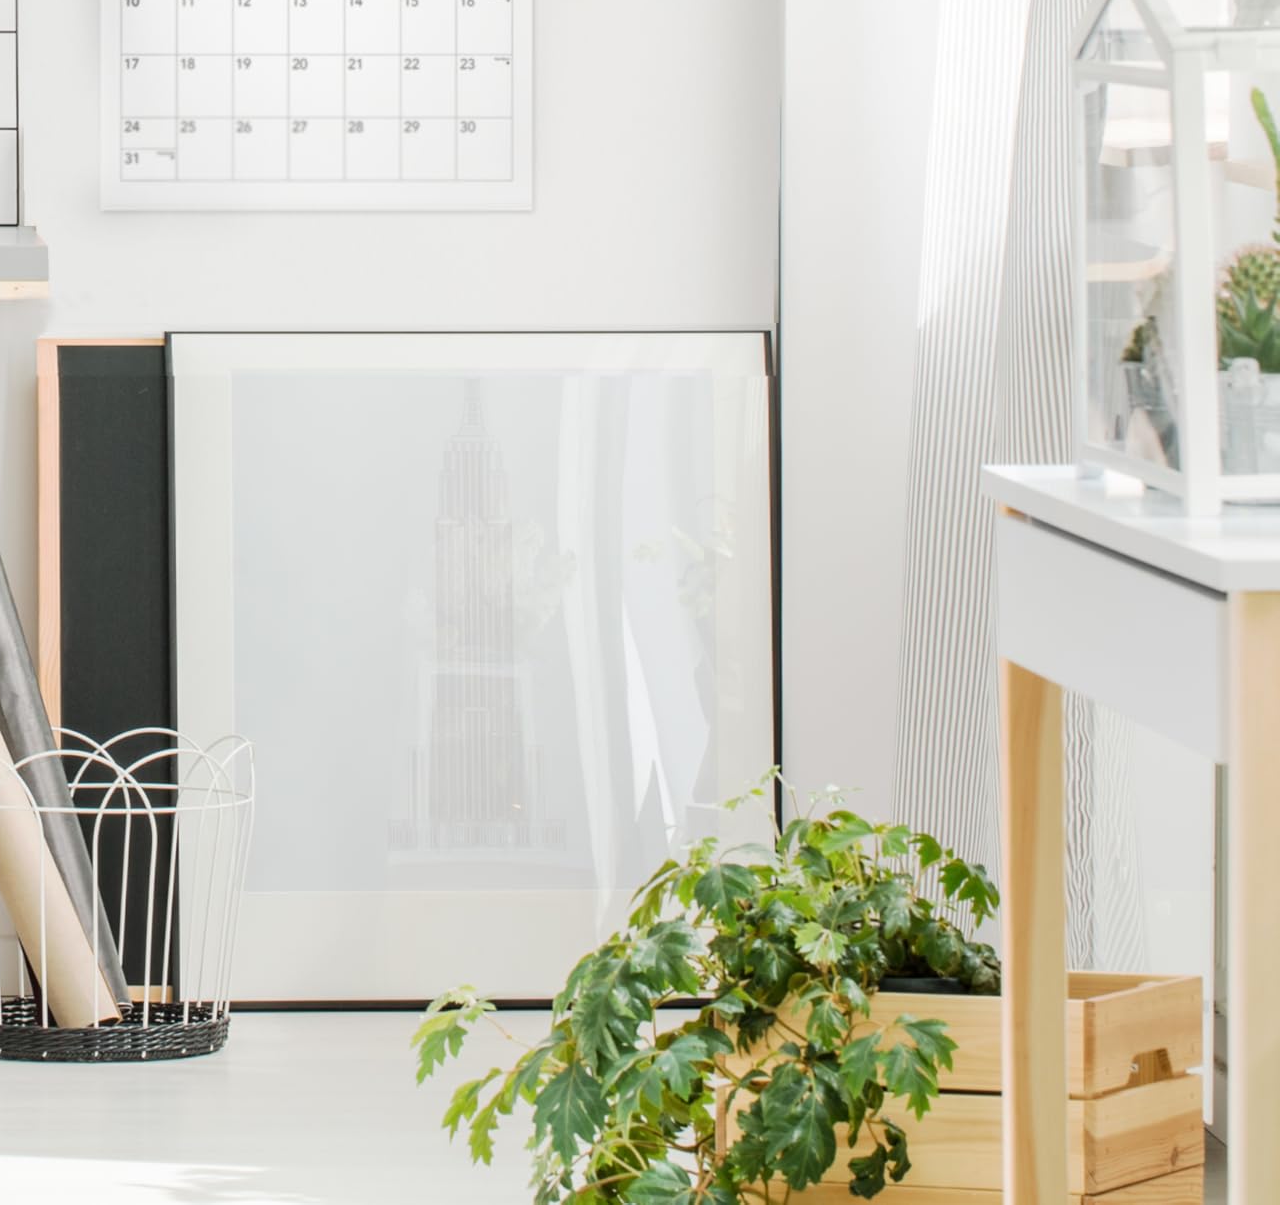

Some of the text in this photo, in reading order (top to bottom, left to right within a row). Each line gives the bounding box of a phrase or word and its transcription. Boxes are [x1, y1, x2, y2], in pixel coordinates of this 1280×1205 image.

[124, 57, 476, 71] 17 18 19 20 21 22 23
[124, 120, 477, 134] 24 25 26 27 28 29 30
[124, 152, 139, 165] 31
